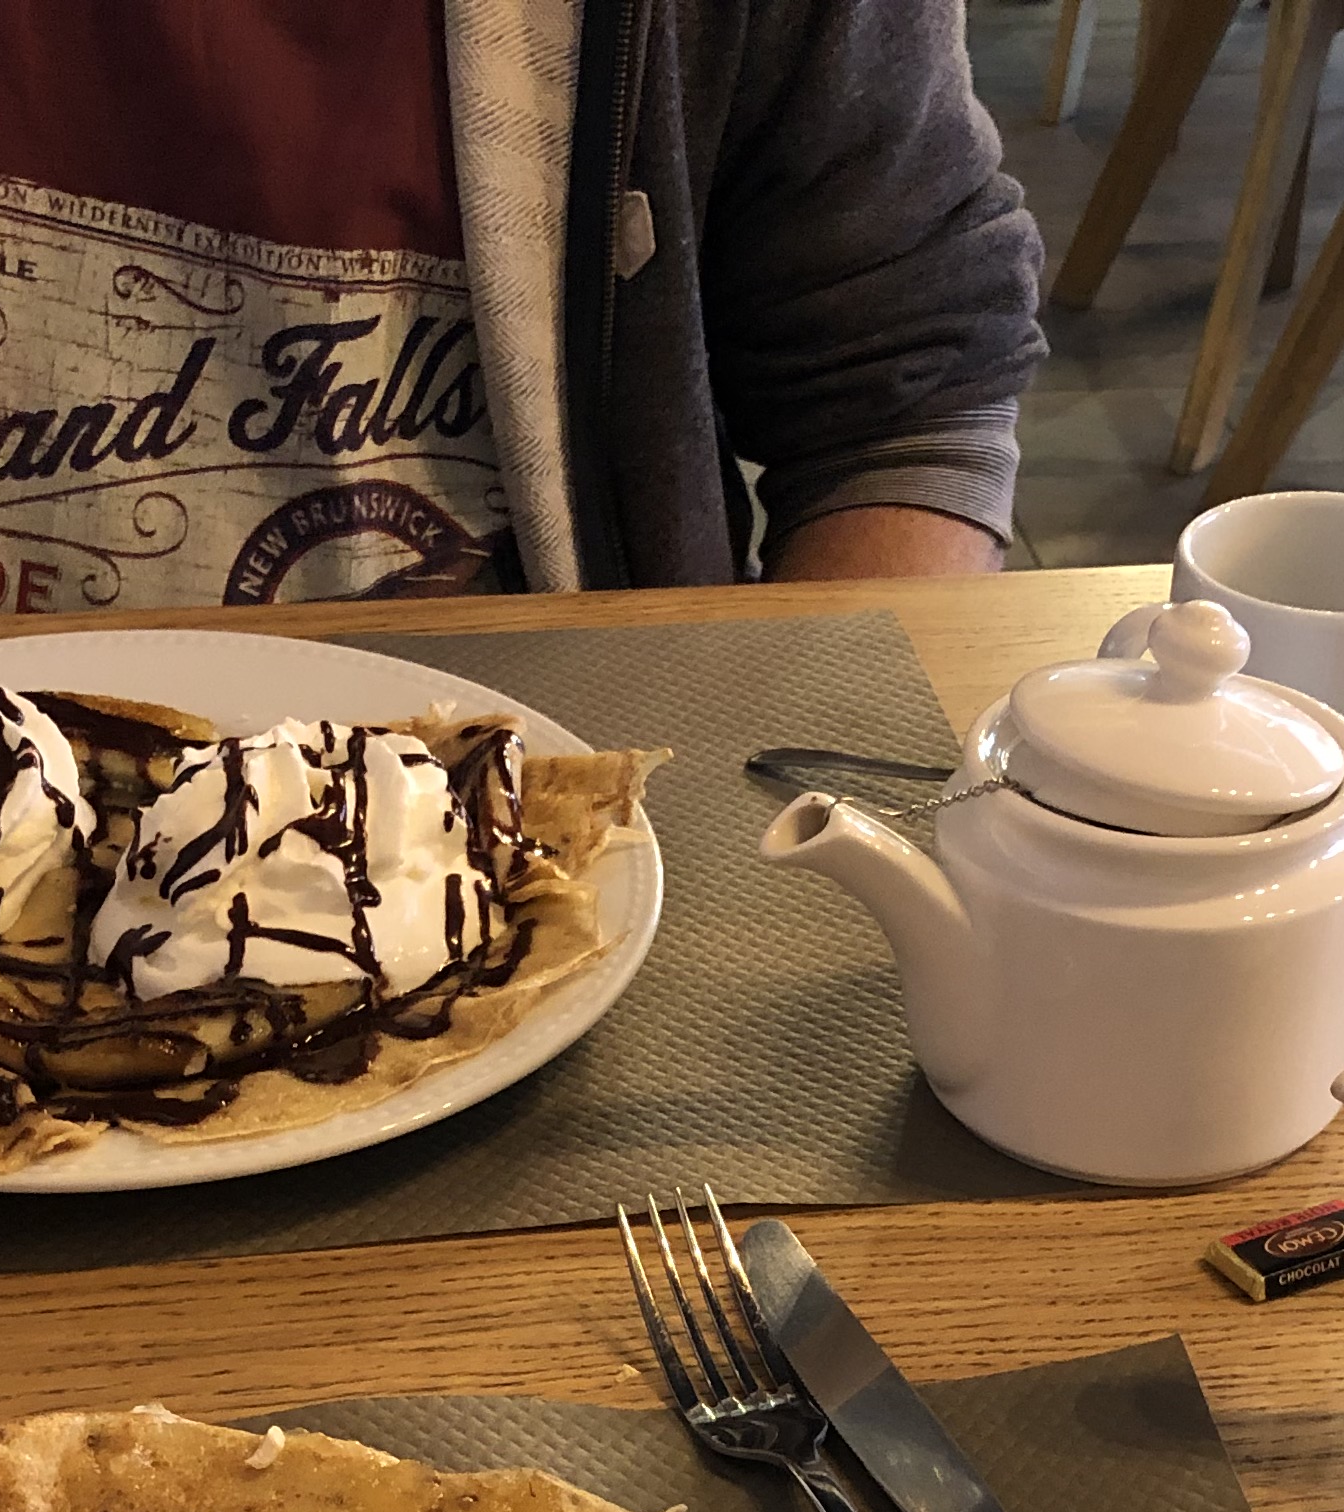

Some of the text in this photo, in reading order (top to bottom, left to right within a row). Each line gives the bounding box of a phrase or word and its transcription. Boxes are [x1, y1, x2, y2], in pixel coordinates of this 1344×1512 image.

[228, 314, 488, 453] Falls
[237, 491, 444, 597] NEW BRUNSWICK
[1277, 1256, 1341, 1286] CHOCOLAT
